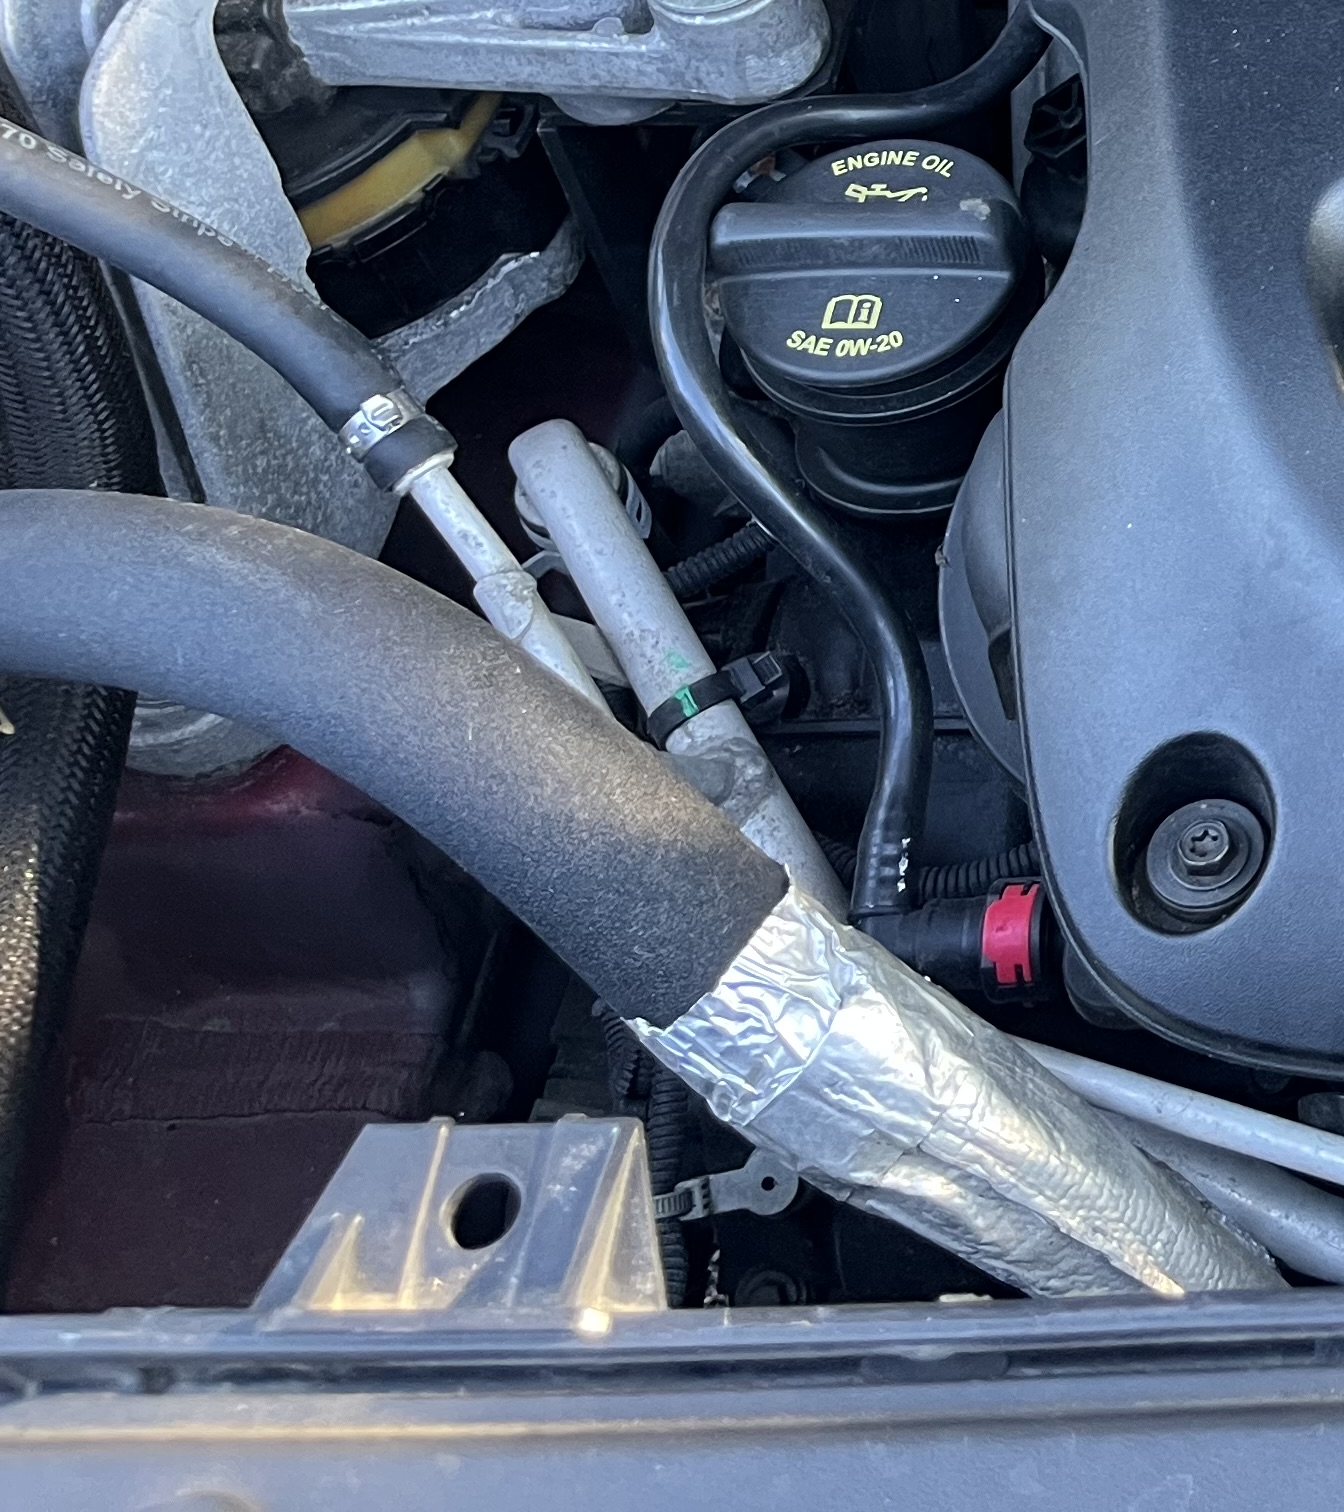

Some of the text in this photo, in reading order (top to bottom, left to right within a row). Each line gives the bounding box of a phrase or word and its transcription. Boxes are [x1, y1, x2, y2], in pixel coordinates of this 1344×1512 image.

[831, 150, 954, 178] ENGINE OIL
[786, 330, 904, 357] SAE 0W-20
